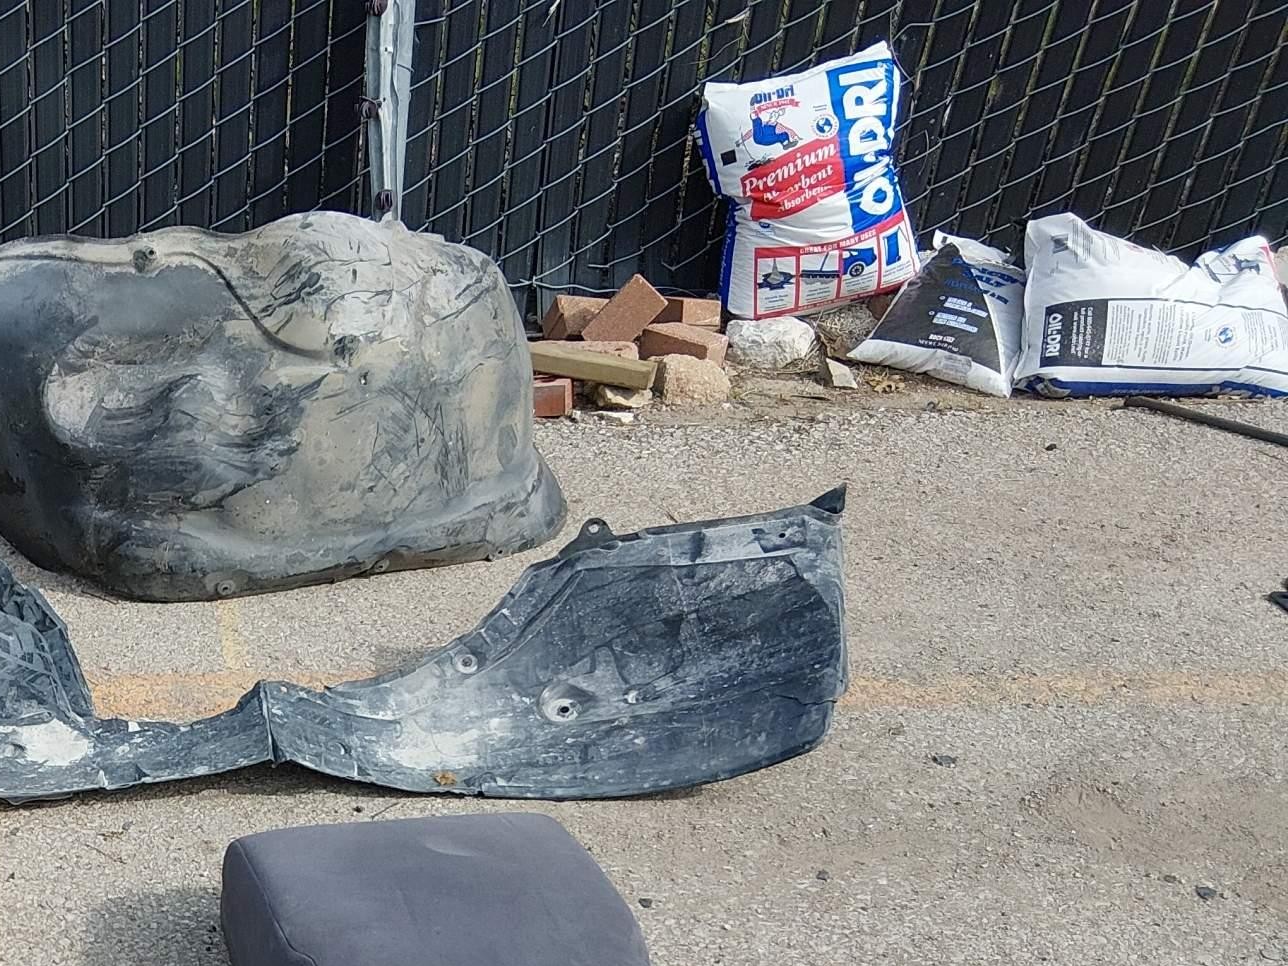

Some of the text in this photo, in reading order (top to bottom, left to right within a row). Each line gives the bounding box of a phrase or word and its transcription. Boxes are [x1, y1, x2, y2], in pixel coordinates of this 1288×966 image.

[743, 142, 838, 197] Premium
[859, 228, 877, 242] USES
[1045, 312, 1063, 358] OIL-DRI
